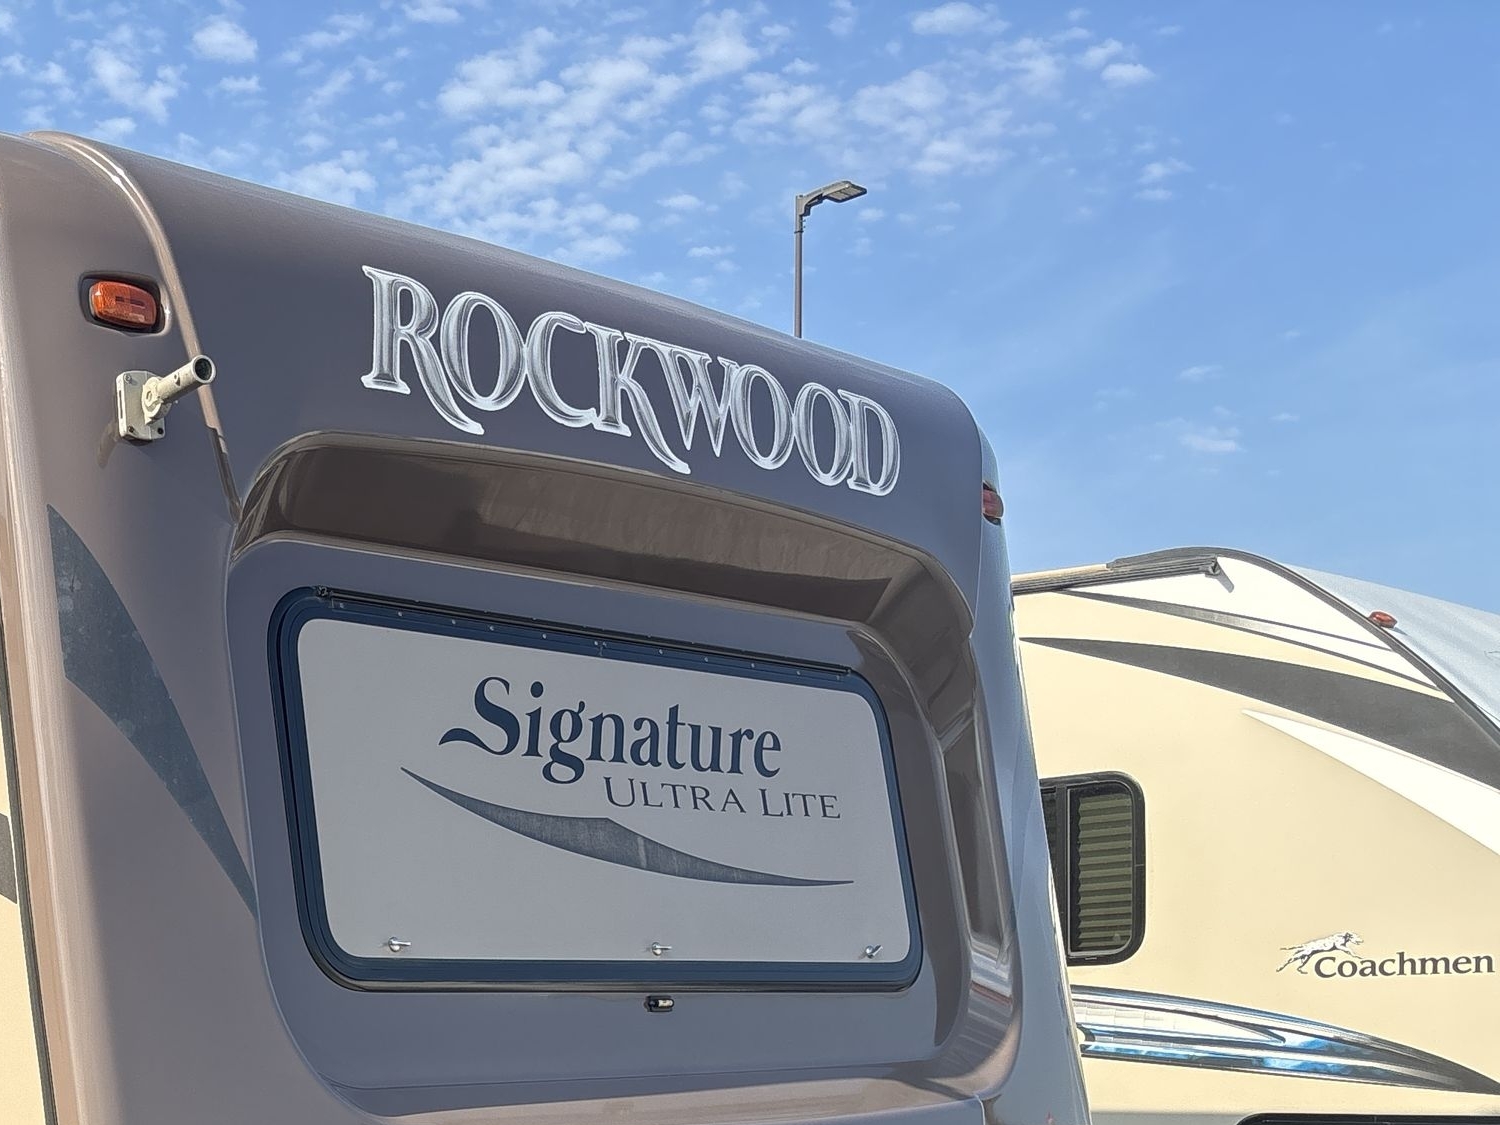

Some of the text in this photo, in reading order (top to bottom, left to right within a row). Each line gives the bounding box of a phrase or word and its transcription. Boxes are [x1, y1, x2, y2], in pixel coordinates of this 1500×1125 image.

[362, 265, 901, 496] ROCKWOOD
[438, 676, 782, 784] Signature
[603, 776, 841, 819] ULTRA LITE
[1314, 951, 1495, 978] Coachmen
